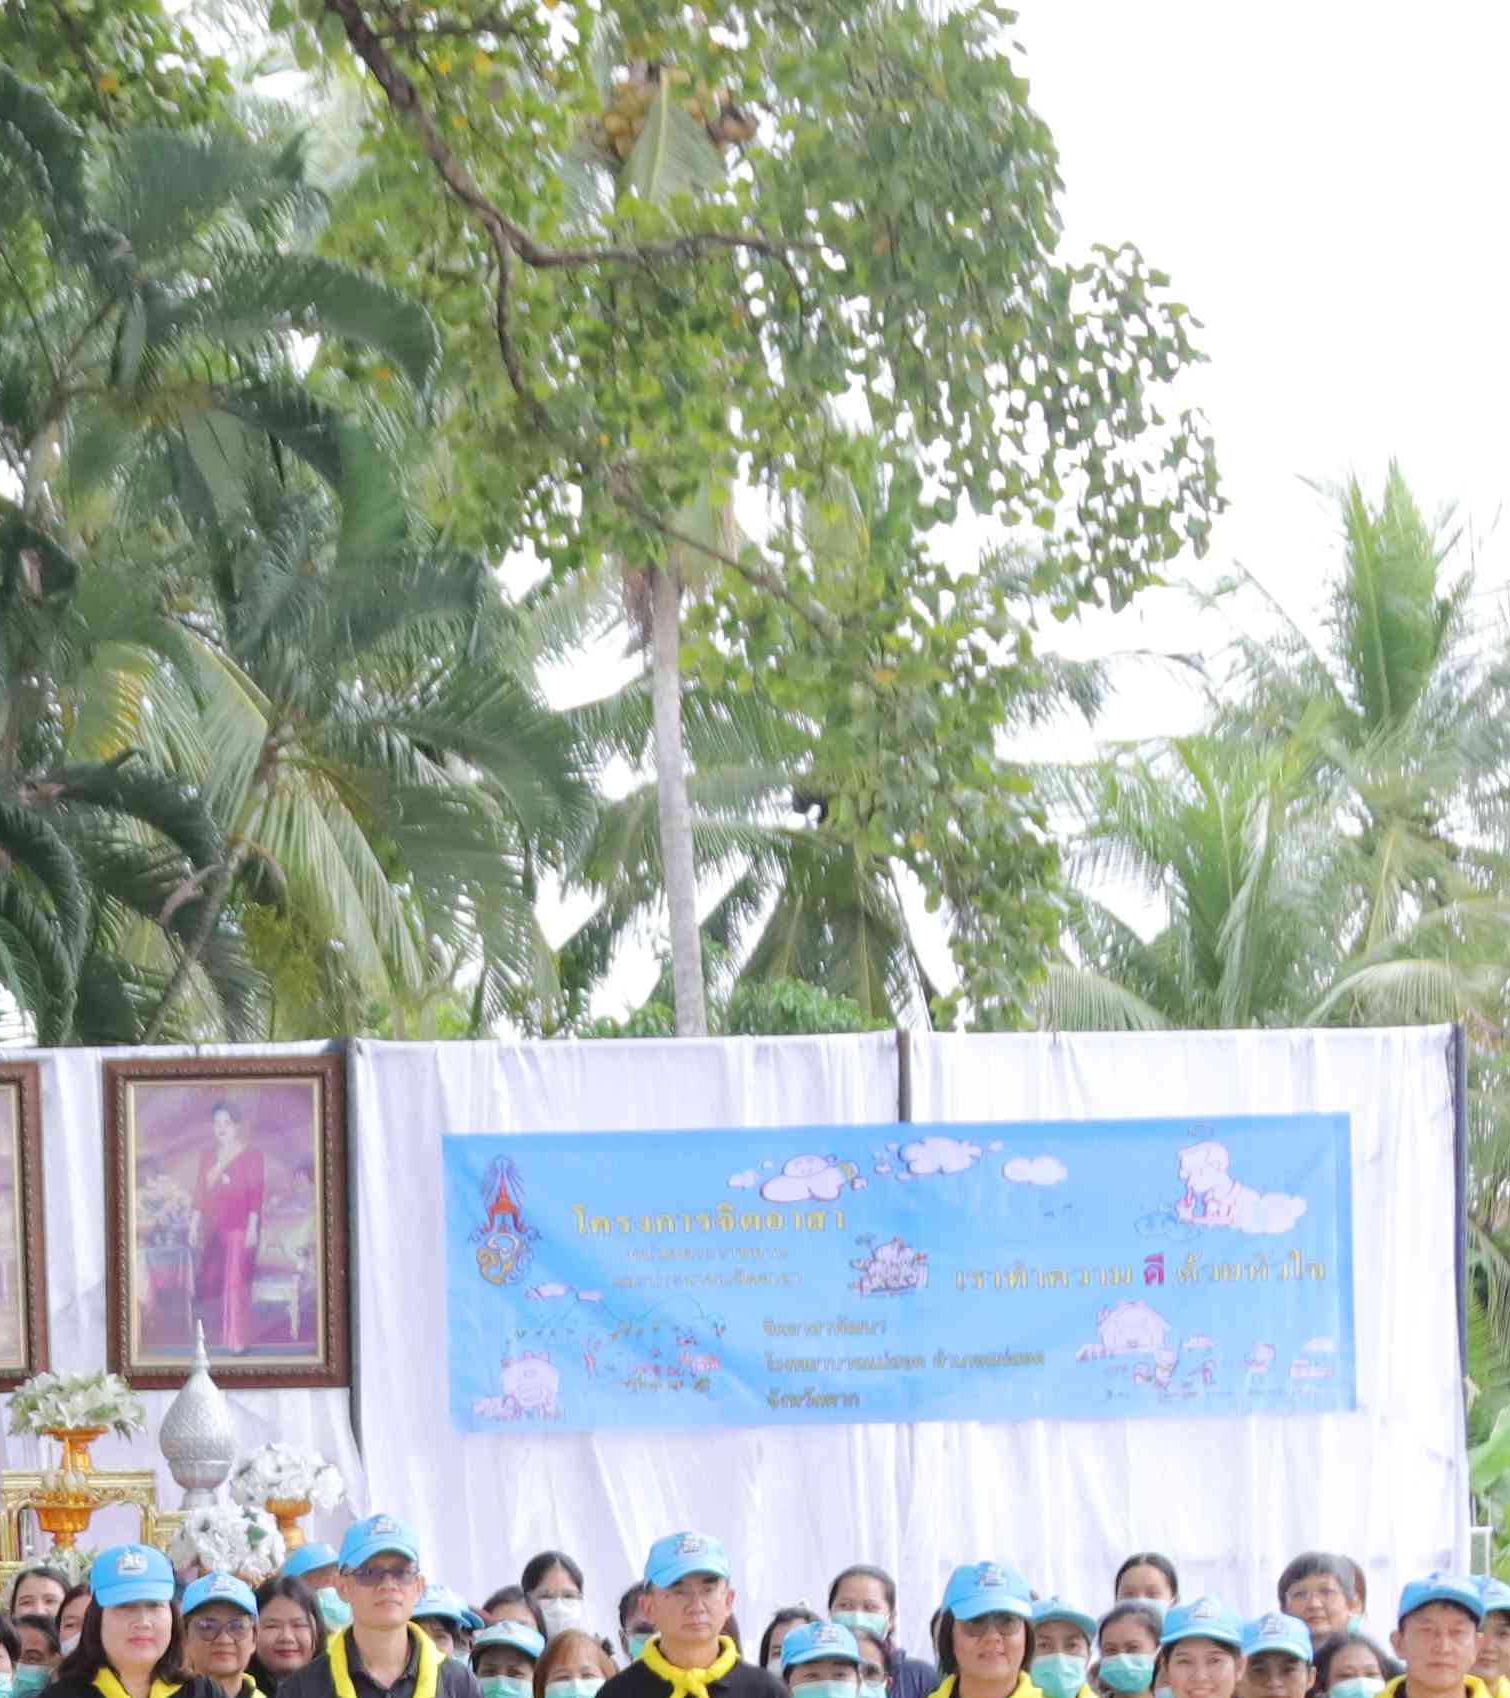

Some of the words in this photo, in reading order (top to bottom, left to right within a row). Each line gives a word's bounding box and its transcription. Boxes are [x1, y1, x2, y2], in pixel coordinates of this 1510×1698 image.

[571, 1203, 847, 1234] โครงการจิตอาสา
[1143, 1251, 1166, 1287] ดี
